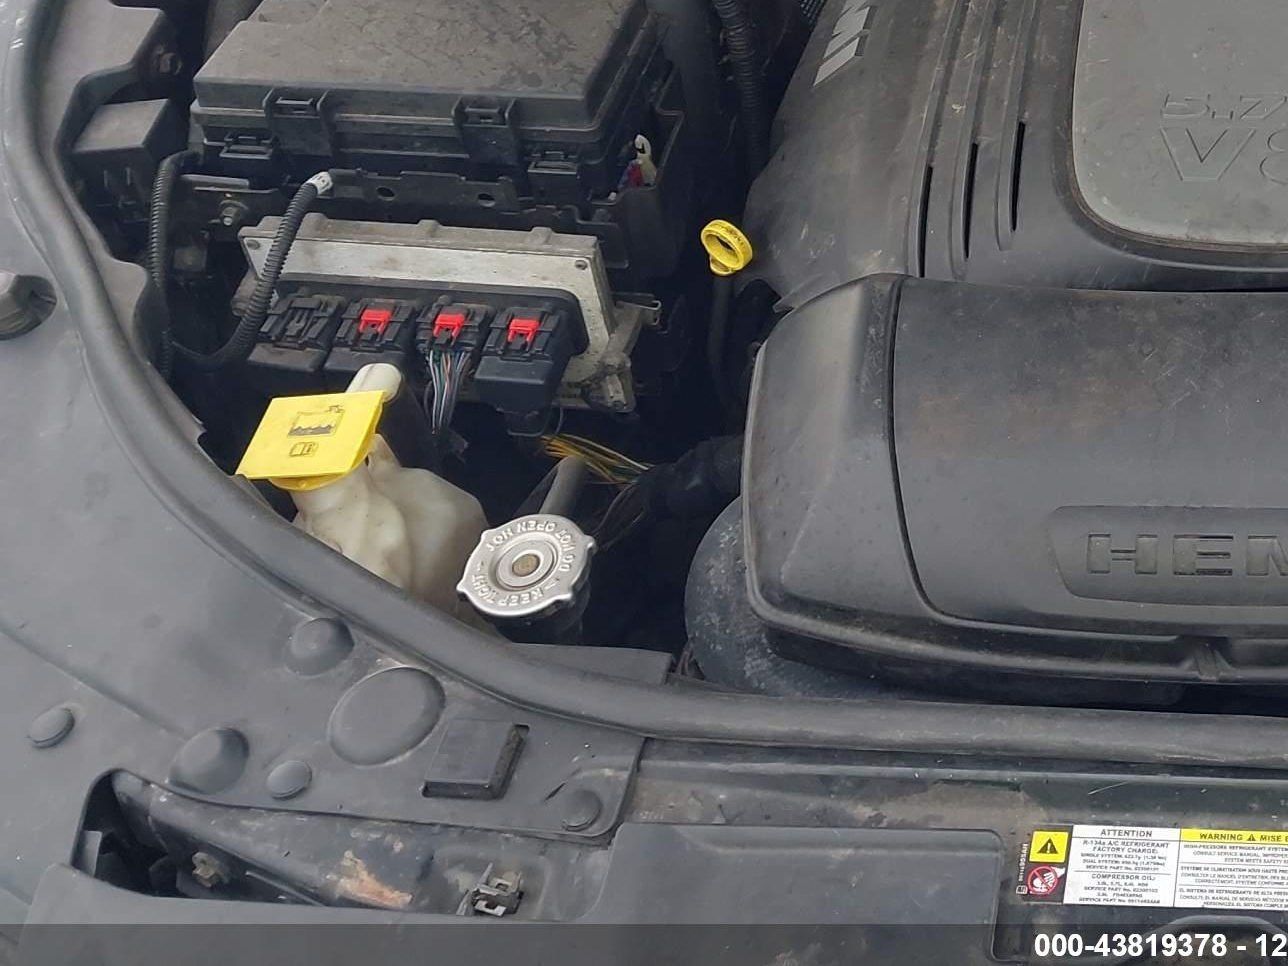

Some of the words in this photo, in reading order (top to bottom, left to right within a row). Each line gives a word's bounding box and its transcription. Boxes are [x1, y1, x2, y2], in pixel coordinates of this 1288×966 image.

[516, 519, 556, 533] OPEN
[497, 587, 545, 607] KEEP
[1100, 829, 1152, 837] ATTENTION
